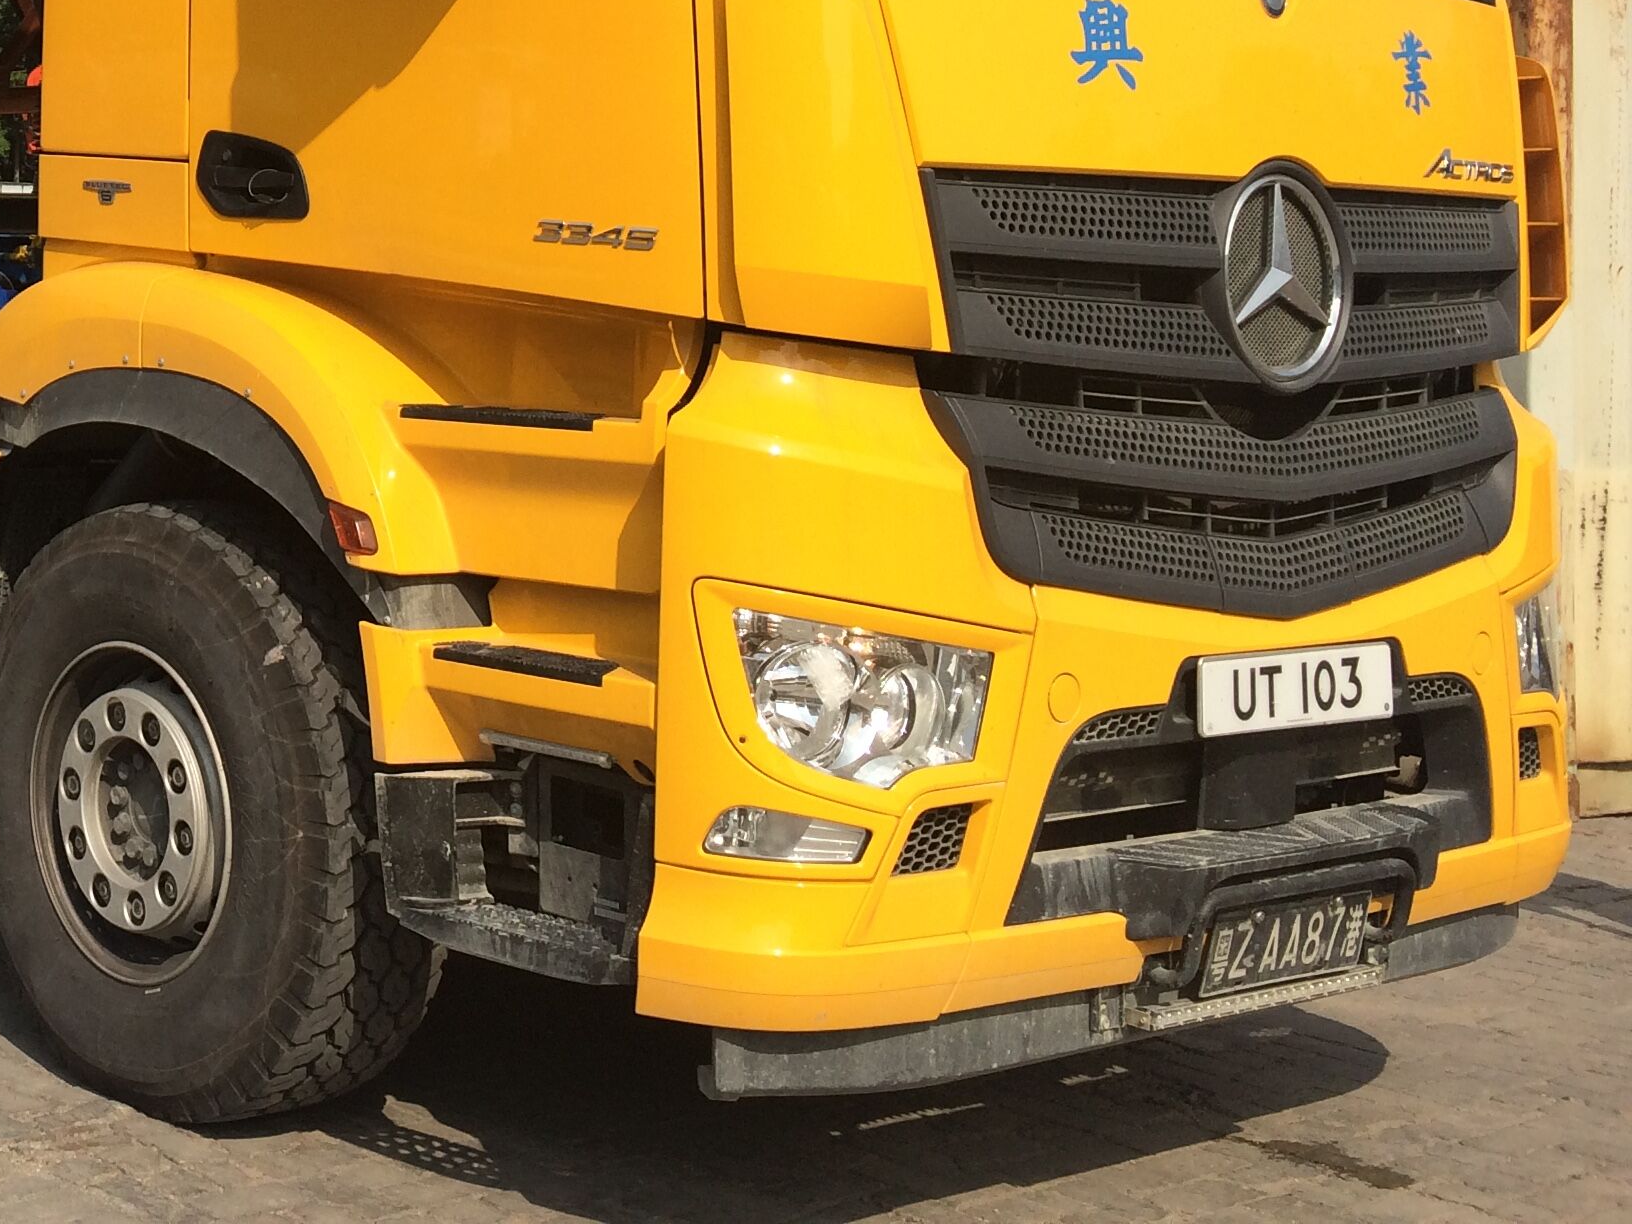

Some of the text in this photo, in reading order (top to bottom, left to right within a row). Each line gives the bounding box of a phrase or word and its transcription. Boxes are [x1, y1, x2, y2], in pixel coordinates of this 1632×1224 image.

[1391, 29, 1432, 115] 業
[533, 219, 659, 251] 3345
[1233, 656, 1363, 721] UT 103
